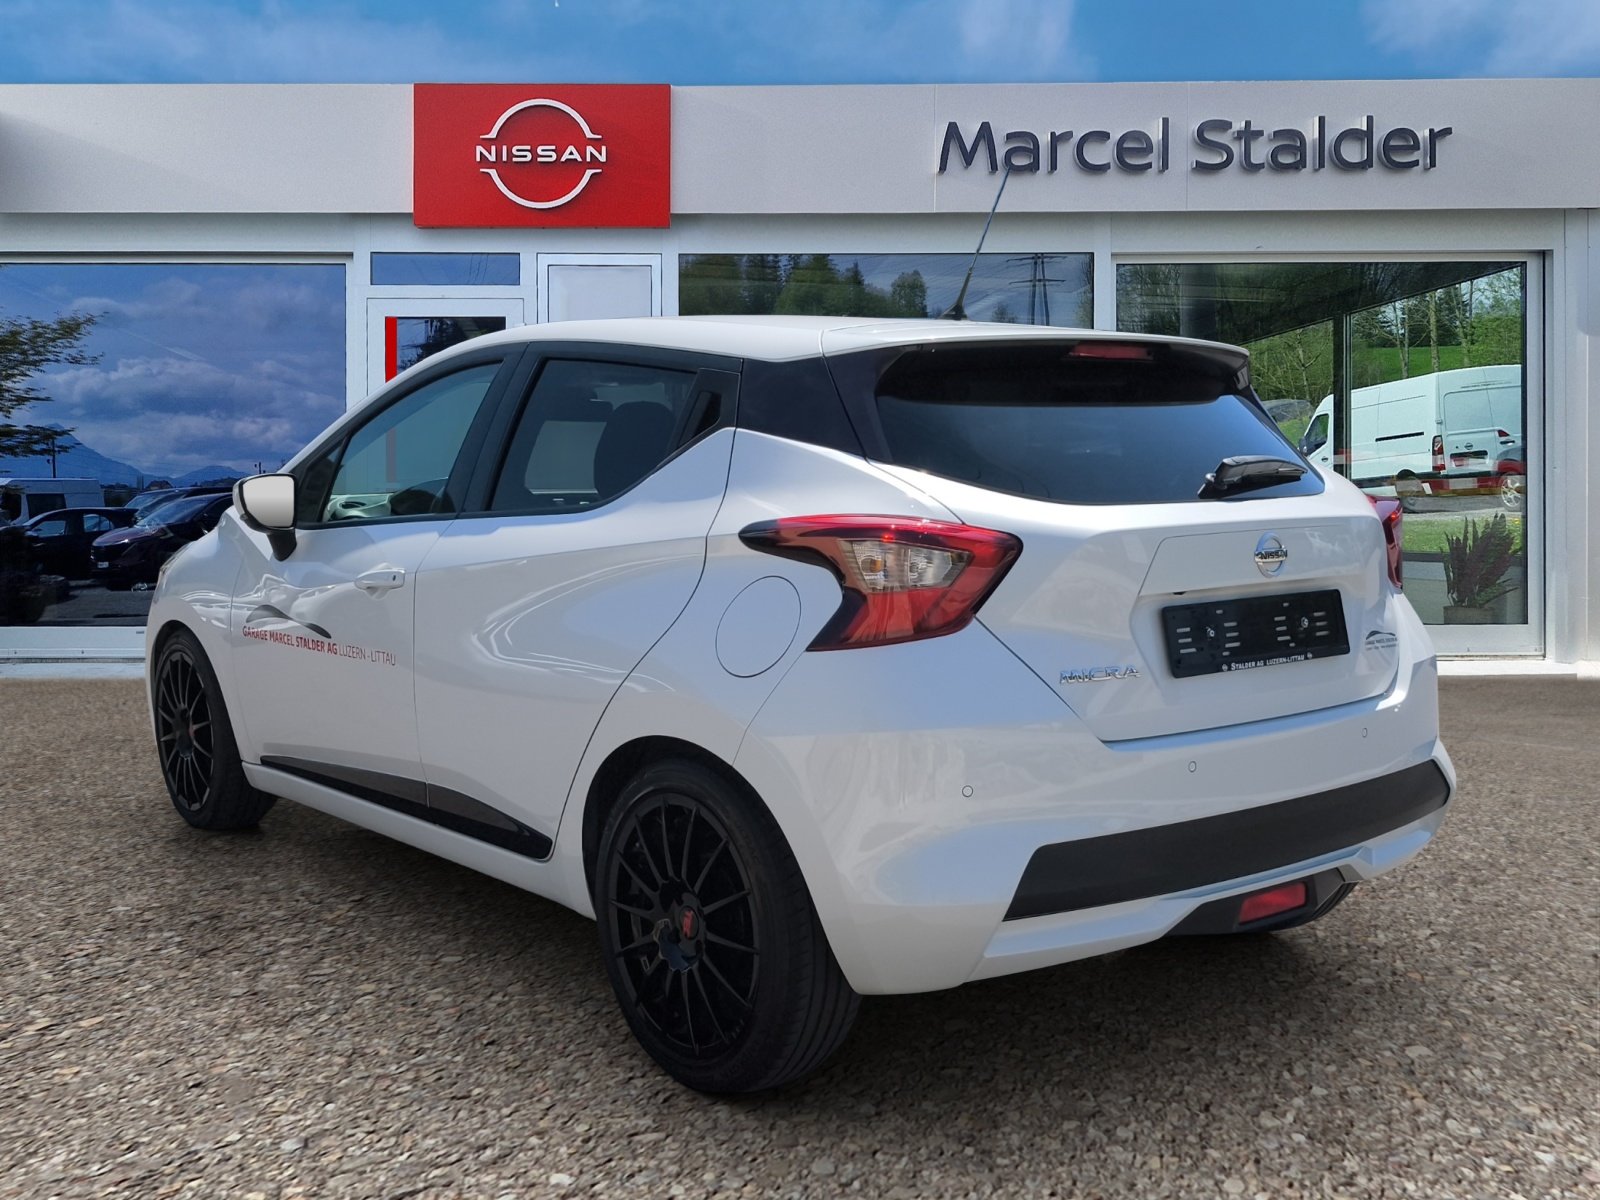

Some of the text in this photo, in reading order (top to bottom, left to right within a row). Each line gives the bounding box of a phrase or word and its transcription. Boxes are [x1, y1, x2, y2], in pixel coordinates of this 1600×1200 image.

[475, 145, 607, 163] NISSAN
[938, 115, 1453, 174] Marcel Stalder
[1256, 549, 1288, 561] NISSAN
[242, 625, 268, 641] GARAGE
[269, 630, 295, 647] MARCEL
[295, 636, 325, 653] STALDER
[327, 642, 338, 656] AG
[1060, 665, 1142, 684] MICRA
